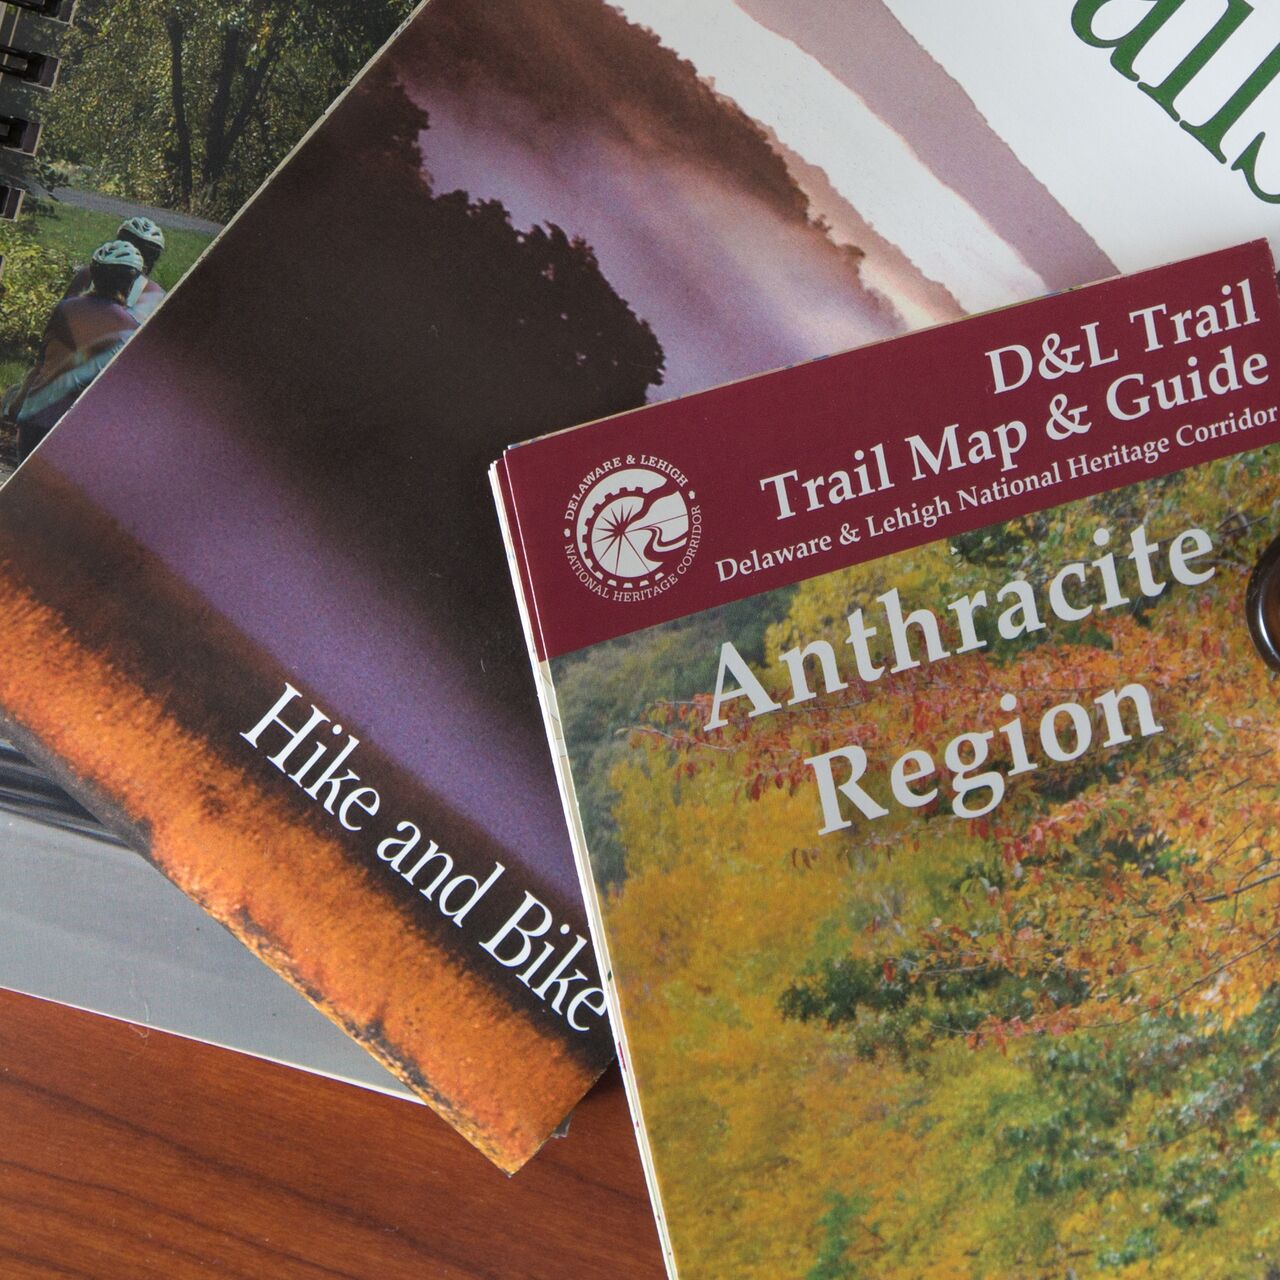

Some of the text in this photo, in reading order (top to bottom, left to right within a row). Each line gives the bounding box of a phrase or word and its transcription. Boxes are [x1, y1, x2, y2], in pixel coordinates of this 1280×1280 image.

[985, 279, 1261, 395] D&L Trail
[564, 454, 689, 521] DELAWARE & LEHIGH
[715, 404, 1279, 584] Delaware & Lehigh National Heritage Corridor
[760, 345, 1271, 521] Trail Map & Guide
[564, 504, 702, 603] NATIONAL HERITAGE CORRIDOR
[701, 518, 1217, 732] Anthracite
[804, 682, 1164, 837] Region
[240, 682, 608, 1032] Hike and Bike
